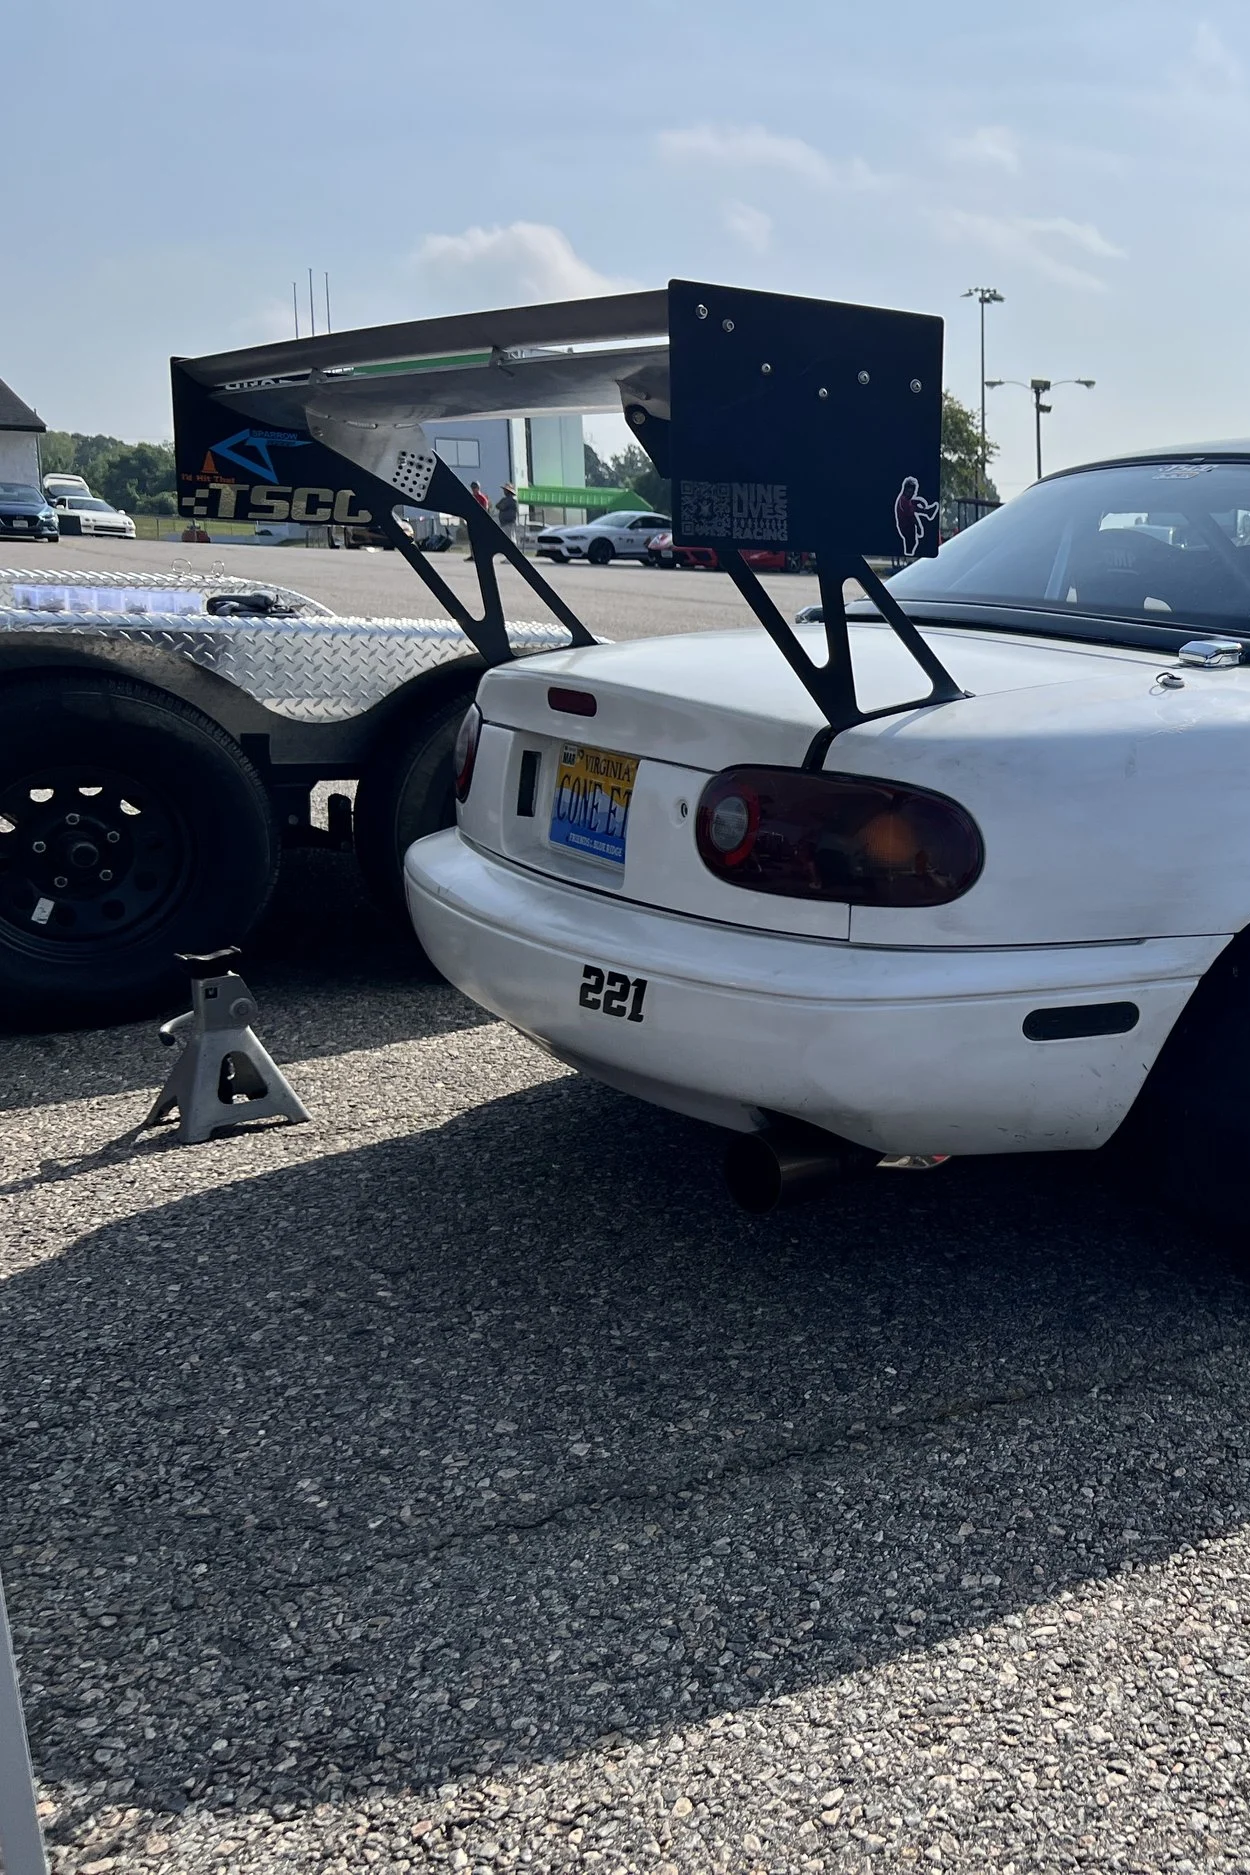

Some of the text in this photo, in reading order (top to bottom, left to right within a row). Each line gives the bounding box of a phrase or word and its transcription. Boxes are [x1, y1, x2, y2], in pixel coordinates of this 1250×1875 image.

[252, 430, 298, 440] SPARROW
[732, 482, 787, 502] NINE
[732, 500, 787, 520] LIVES
[732, 527, 788, 542] RACING
[585, 754, 631, 783] VIRGINIA
[557, 774, 603, 832] CONE
[579, 964, 648, 1023] 221
